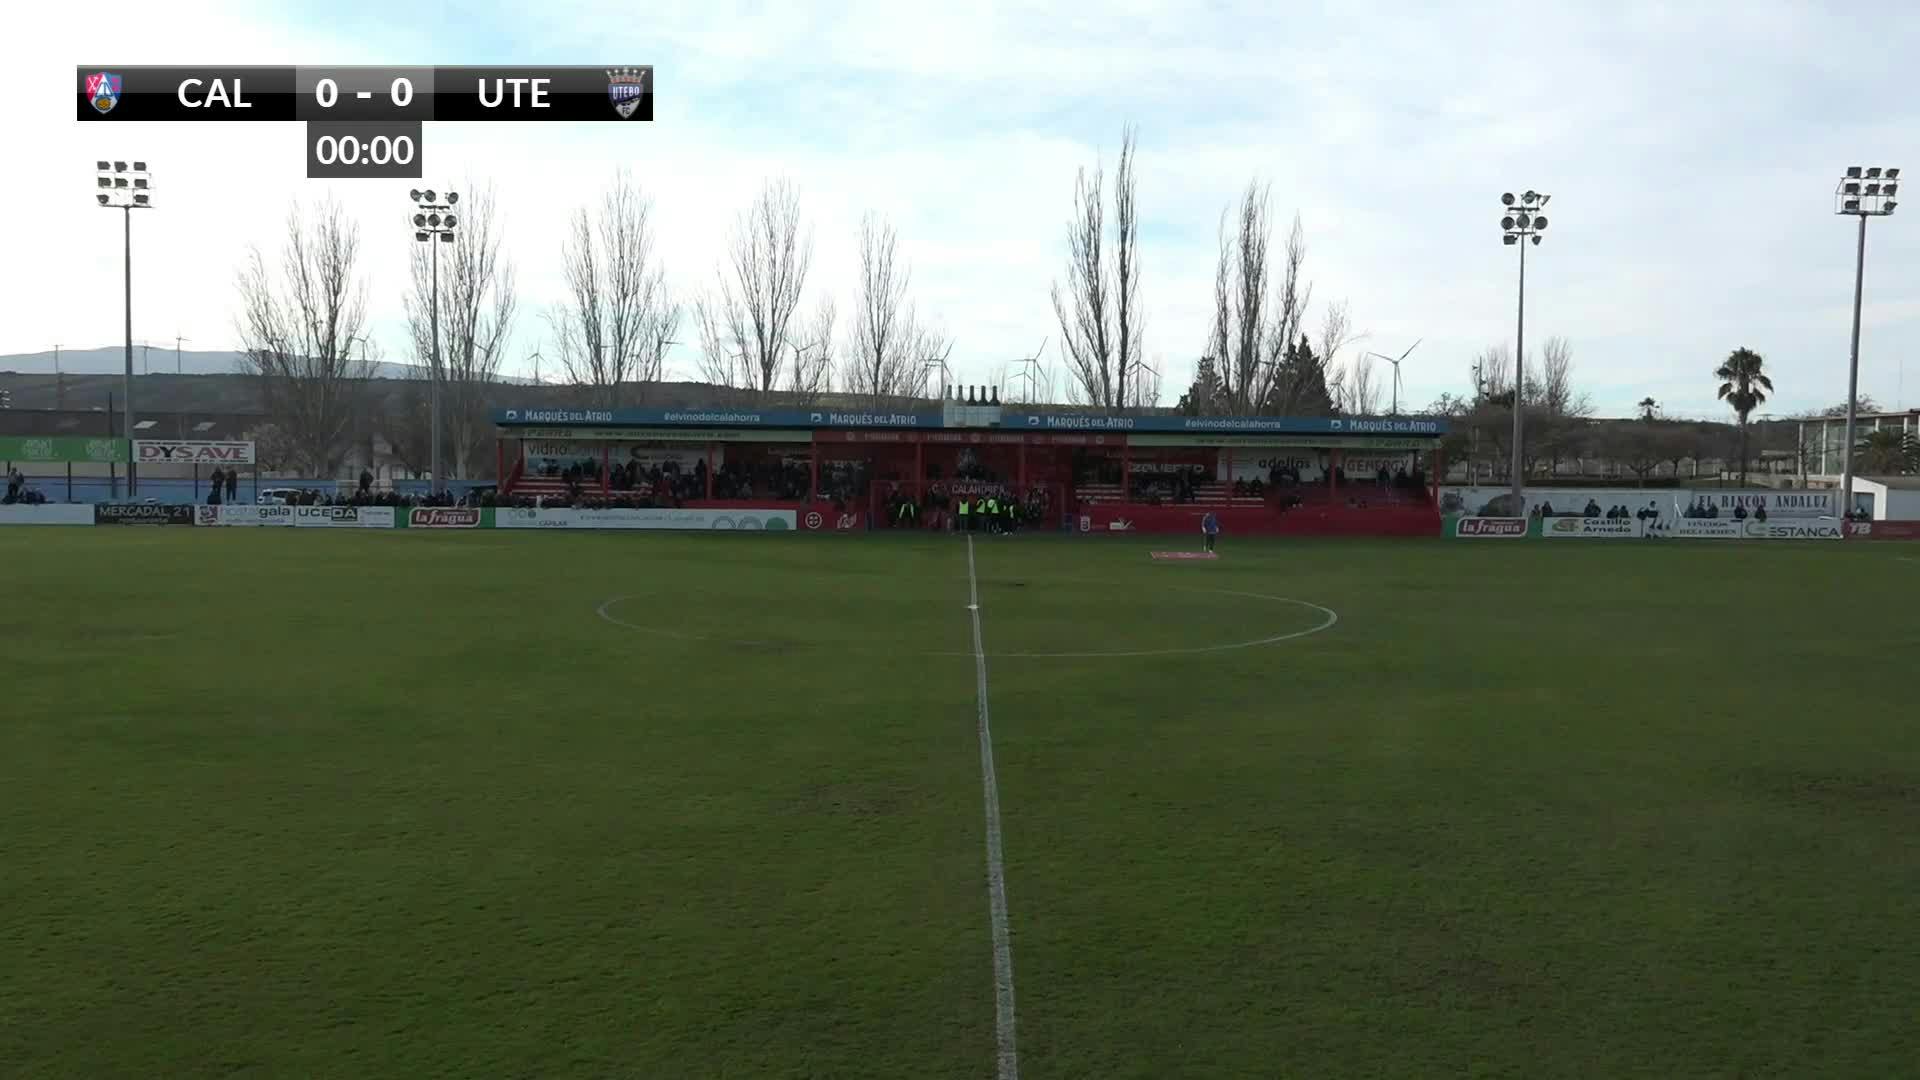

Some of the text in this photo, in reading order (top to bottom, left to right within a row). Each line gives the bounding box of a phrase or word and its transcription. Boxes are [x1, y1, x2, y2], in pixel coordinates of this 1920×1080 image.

[139, 446, 248, 459] DYSAVE
[1775, 495, 1828, 508] ANDALUZ
[298, 507, 357, 518] UCEDA
